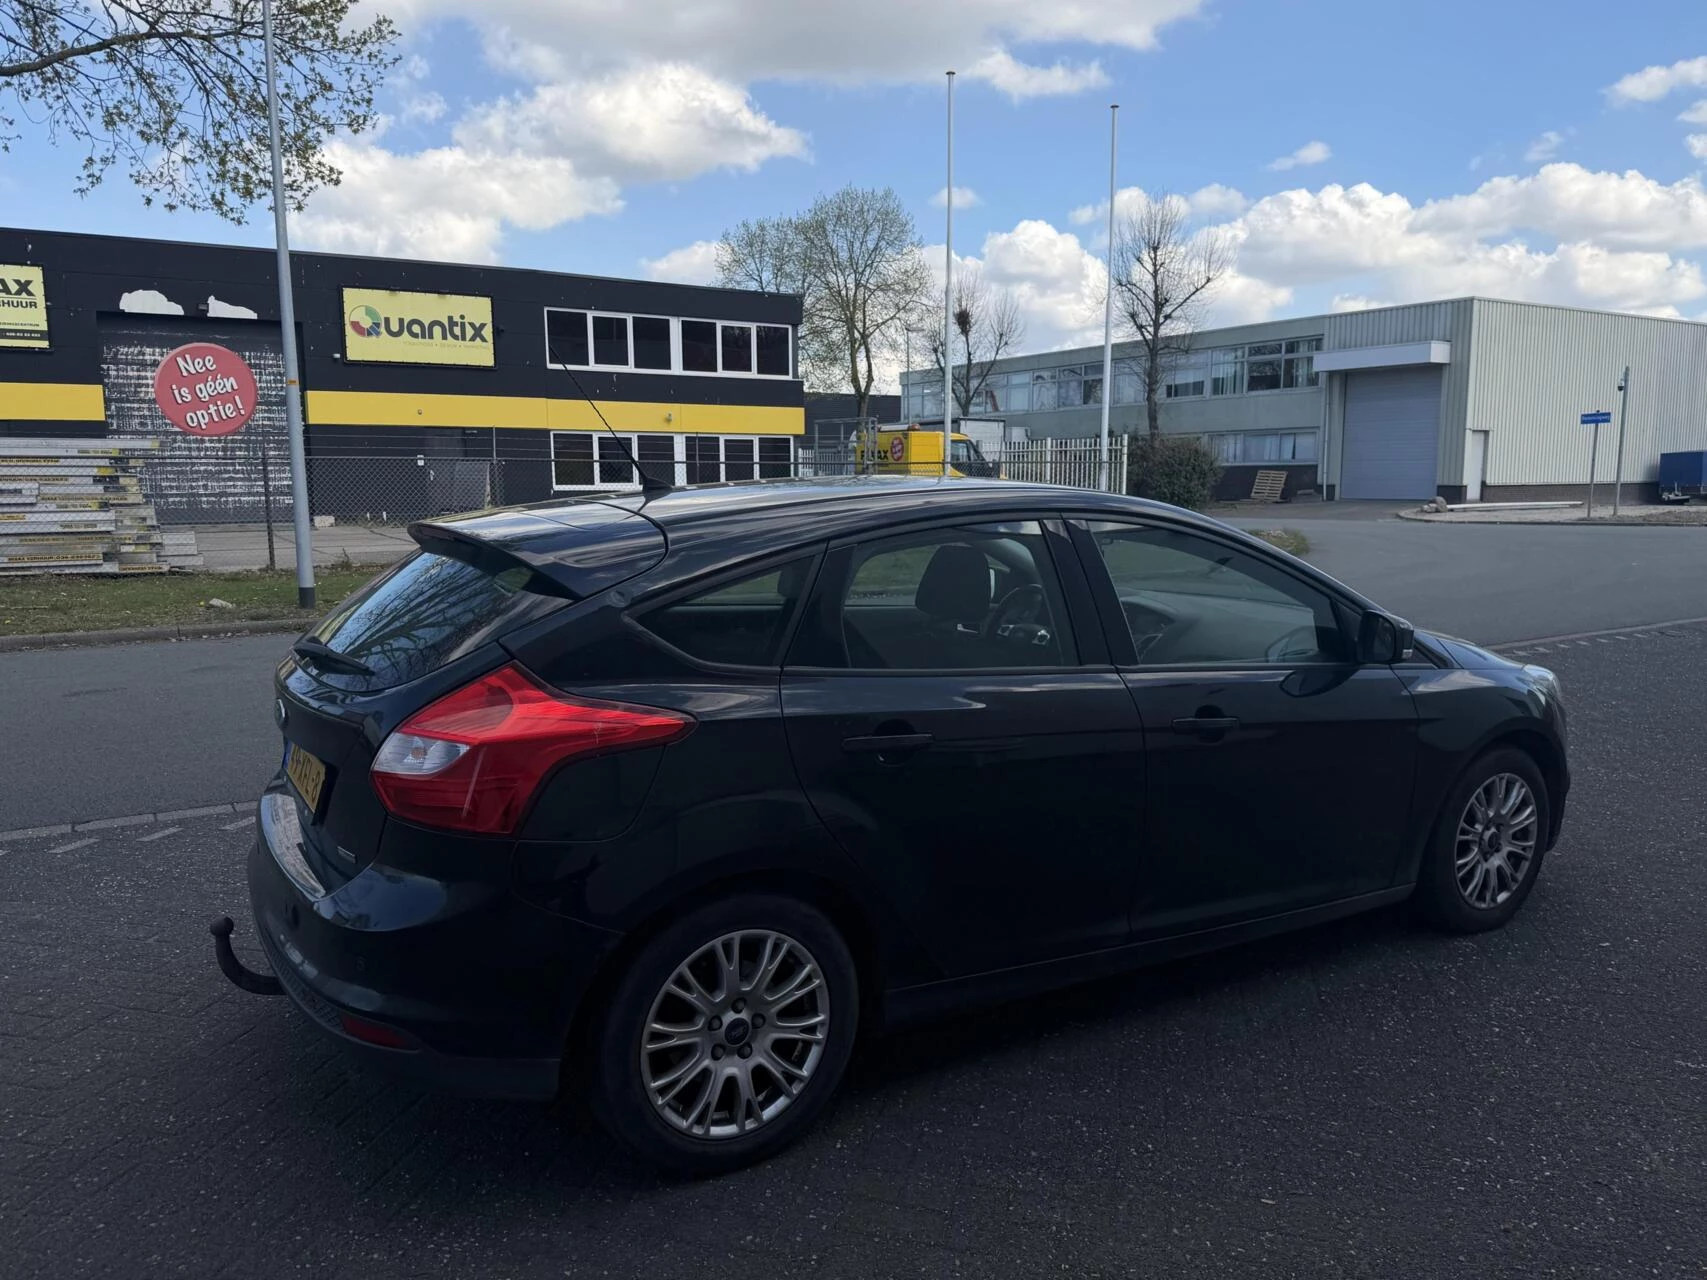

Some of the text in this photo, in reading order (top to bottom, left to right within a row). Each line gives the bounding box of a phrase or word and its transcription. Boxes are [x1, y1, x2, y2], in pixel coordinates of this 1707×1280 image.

[0, 299, 38, 309] HUUR
[176, 354, 216, 377] Nee
[171, 373, 238, 404] is géén
[185, 395, 245, 429] optie!
